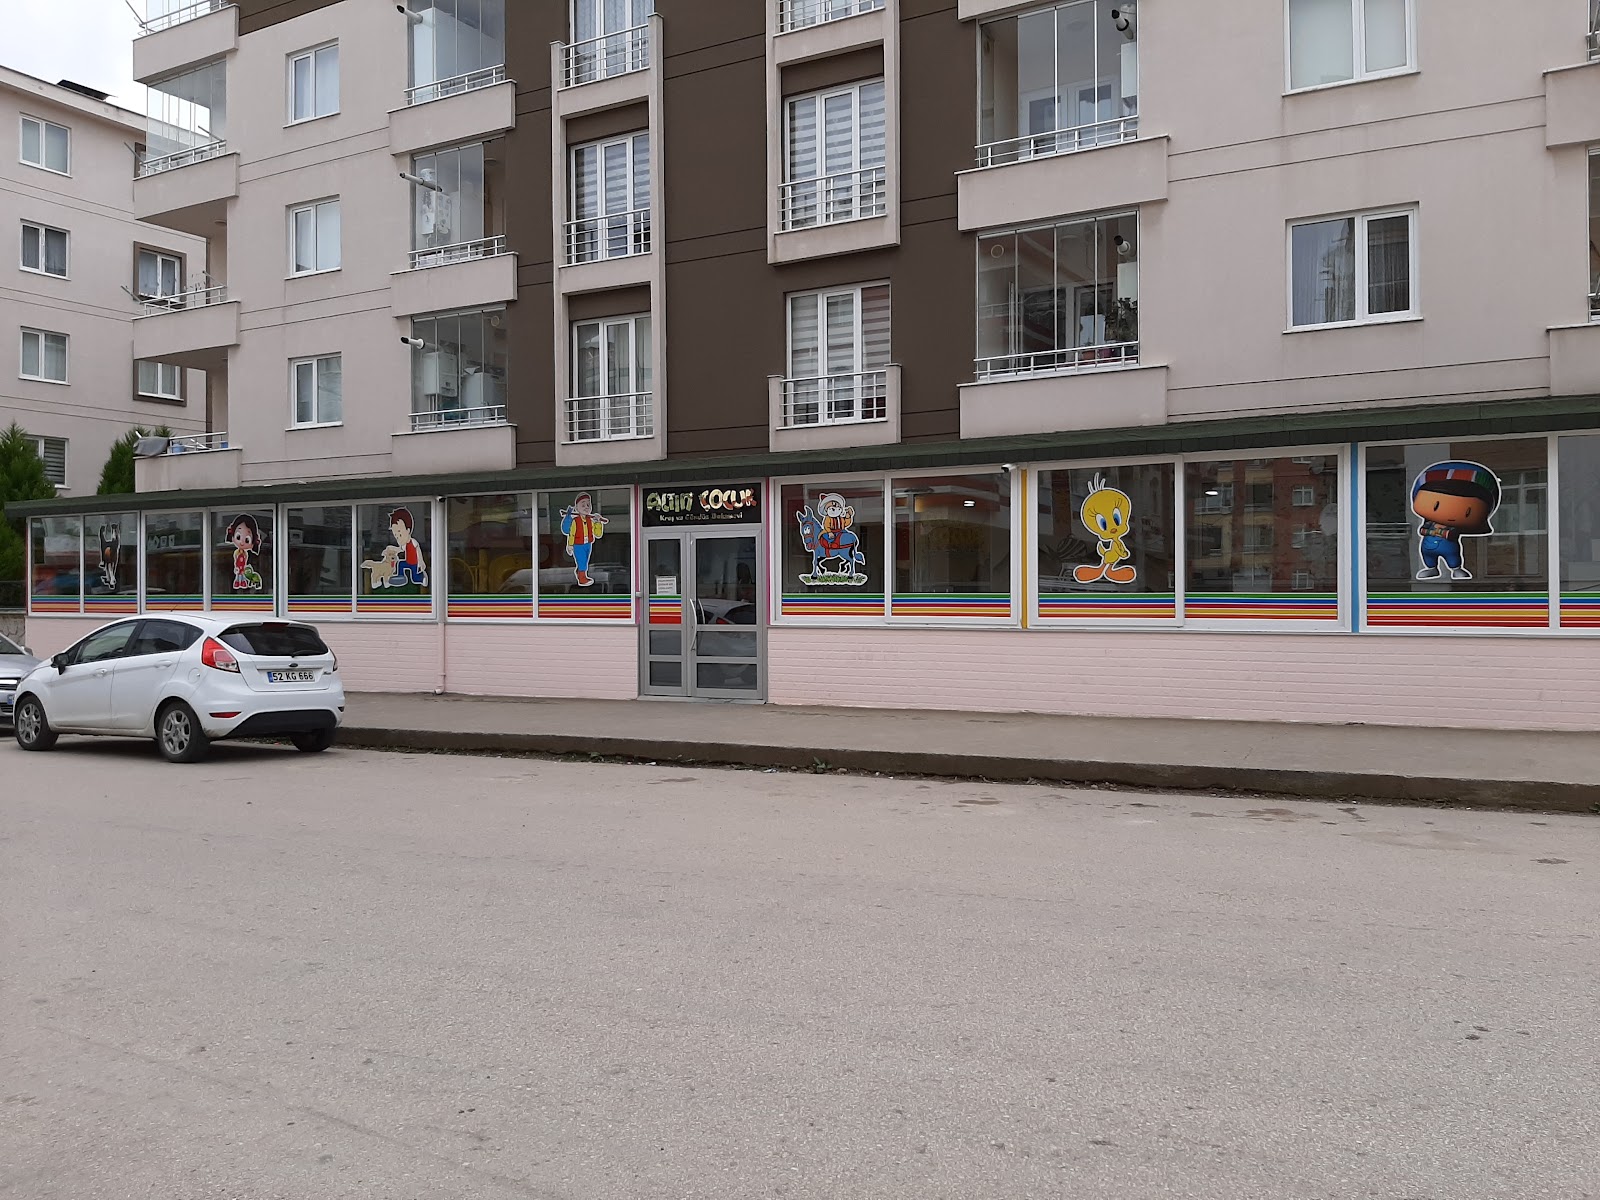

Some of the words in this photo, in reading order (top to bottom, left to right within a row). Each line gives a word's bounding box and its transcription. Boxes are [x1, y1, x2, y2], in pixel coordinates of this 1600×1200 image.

[699, 488, 757, 512] ÇOCUK
[273, 673, 284, 681] 52
[285, 672, 297, 680] KG
[298, 672, 314, 680] 666
